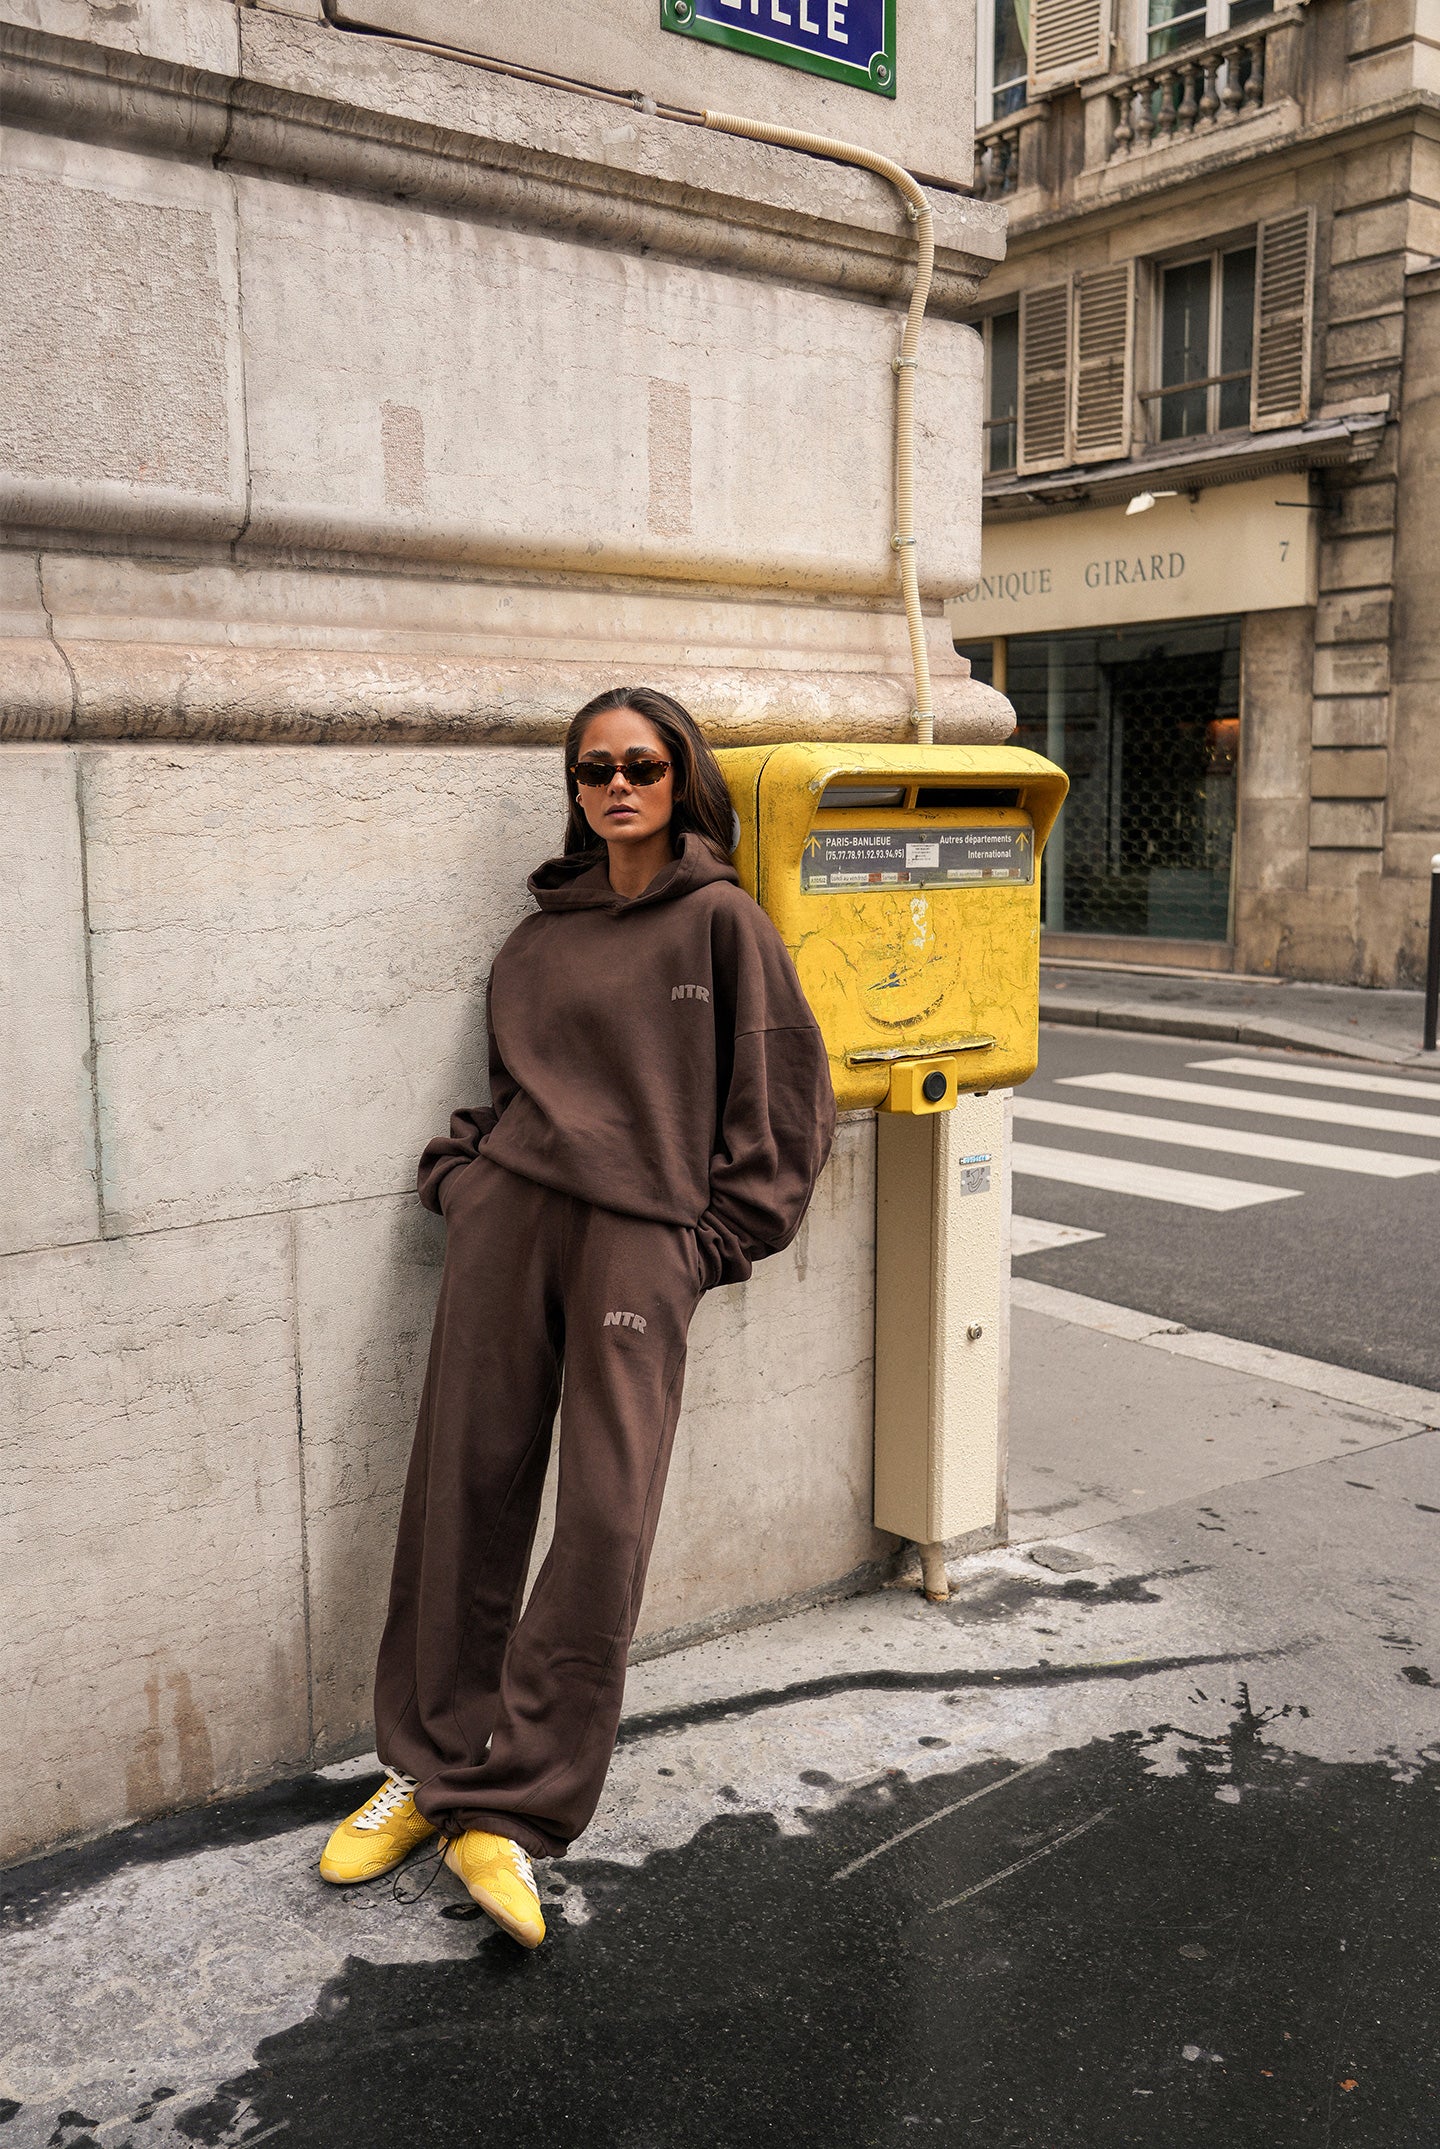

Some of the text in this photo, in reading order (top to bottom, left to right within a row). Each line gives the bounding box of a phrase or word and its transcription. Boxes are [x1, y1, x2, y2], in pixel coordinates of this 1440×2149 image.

[1279, 541, 1290, 562] 7
[1084, 552, 1186, 588] GIRARD
[825, 836, 892, 847] PARIS-BANLIEUE
[939, 834, 1012, 845] Autres départements
[967, 849, 1012, 859] International
[671, 984, 710, 1003] NTR
[603, 1311, 647, 1335] NTR
